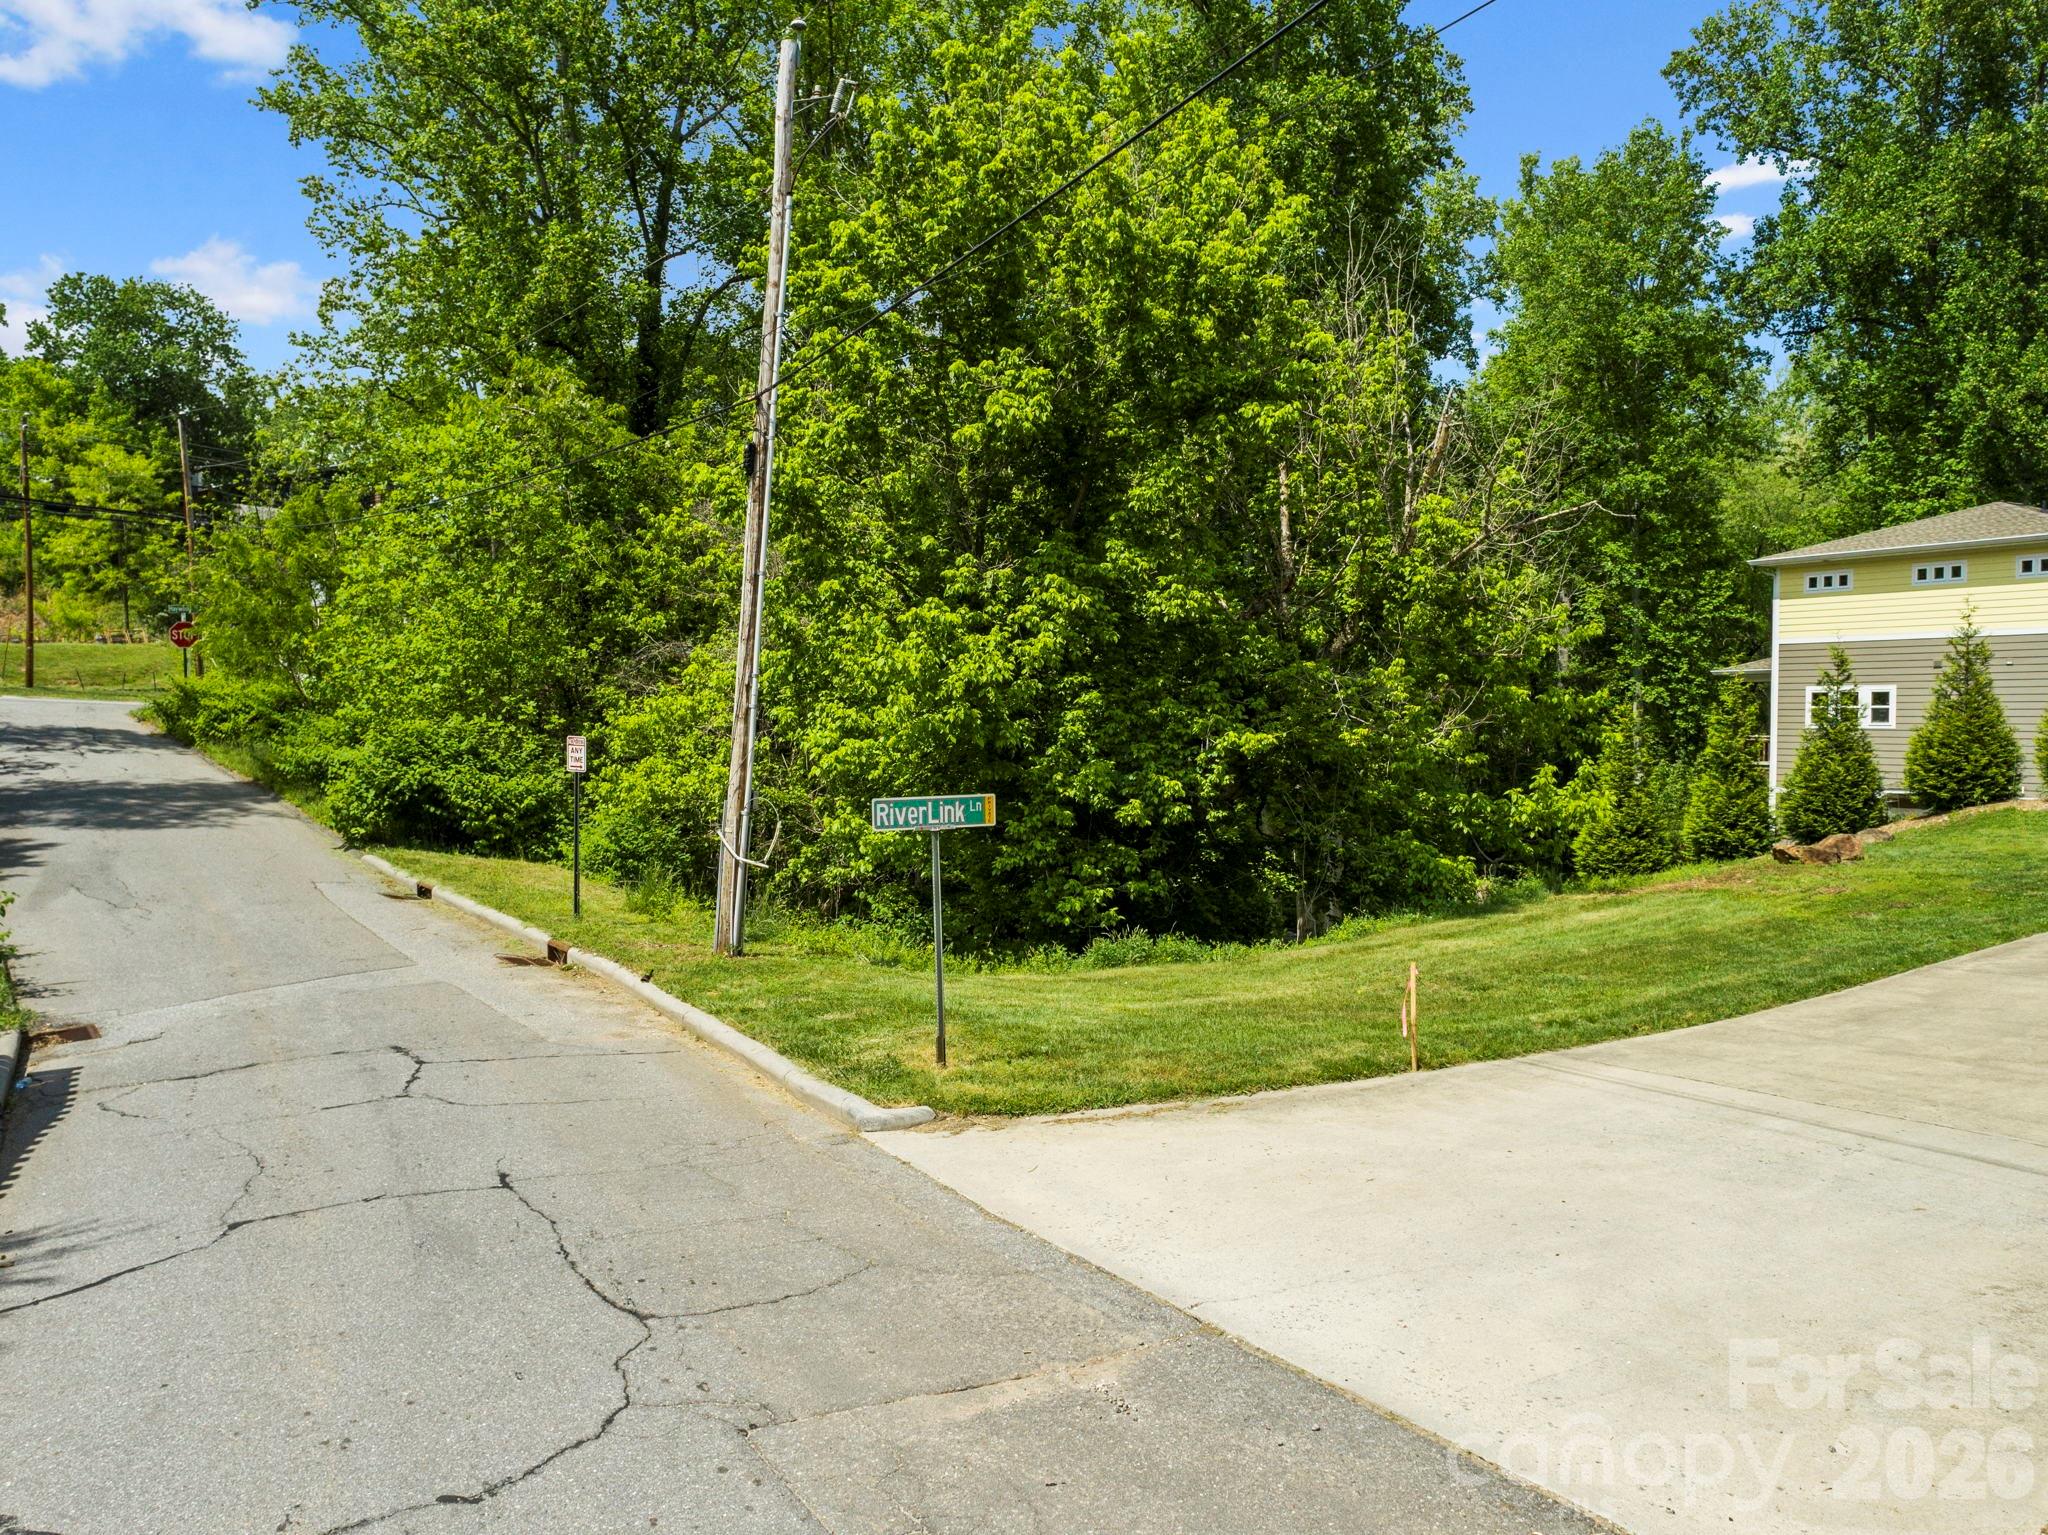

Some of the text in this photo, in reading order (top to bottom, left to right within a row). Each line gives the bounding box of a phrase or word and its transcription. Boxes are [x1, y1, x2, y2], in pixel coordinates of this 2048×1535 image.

[570, 756, 584, 764] TIME
[876, 799, 982, 826] RiverLink Ln
